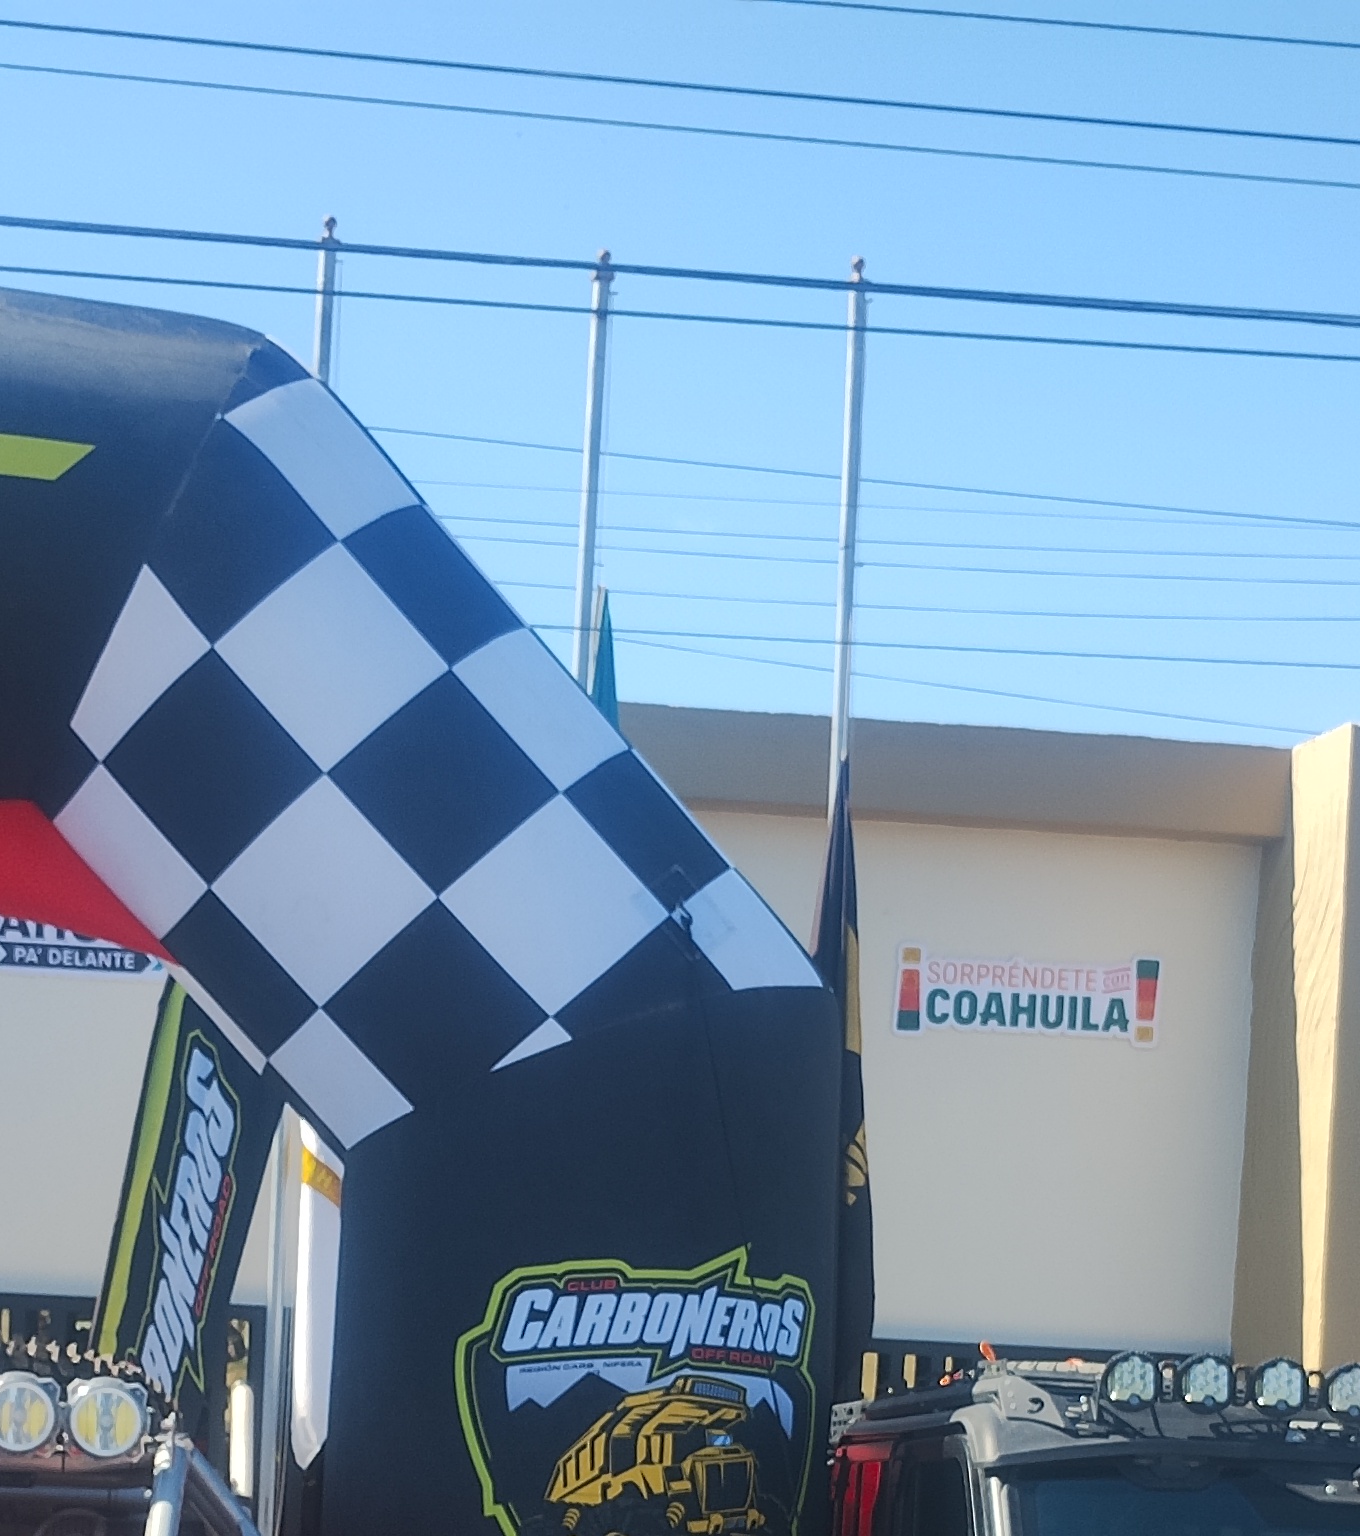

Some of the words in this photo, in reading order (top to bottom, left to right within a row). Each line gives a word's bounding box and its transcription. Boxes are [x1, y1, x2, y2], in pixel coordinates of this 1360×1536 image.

[48, 949, 136, 970] DELANTE
[925, 988, 1129, 1033] COAHUILA
[567, 1279, 618, 1292] CLUB
[501, 1285, 805, 1359] CARBONEROS
[691, 1347, 726, 1360] OFF
